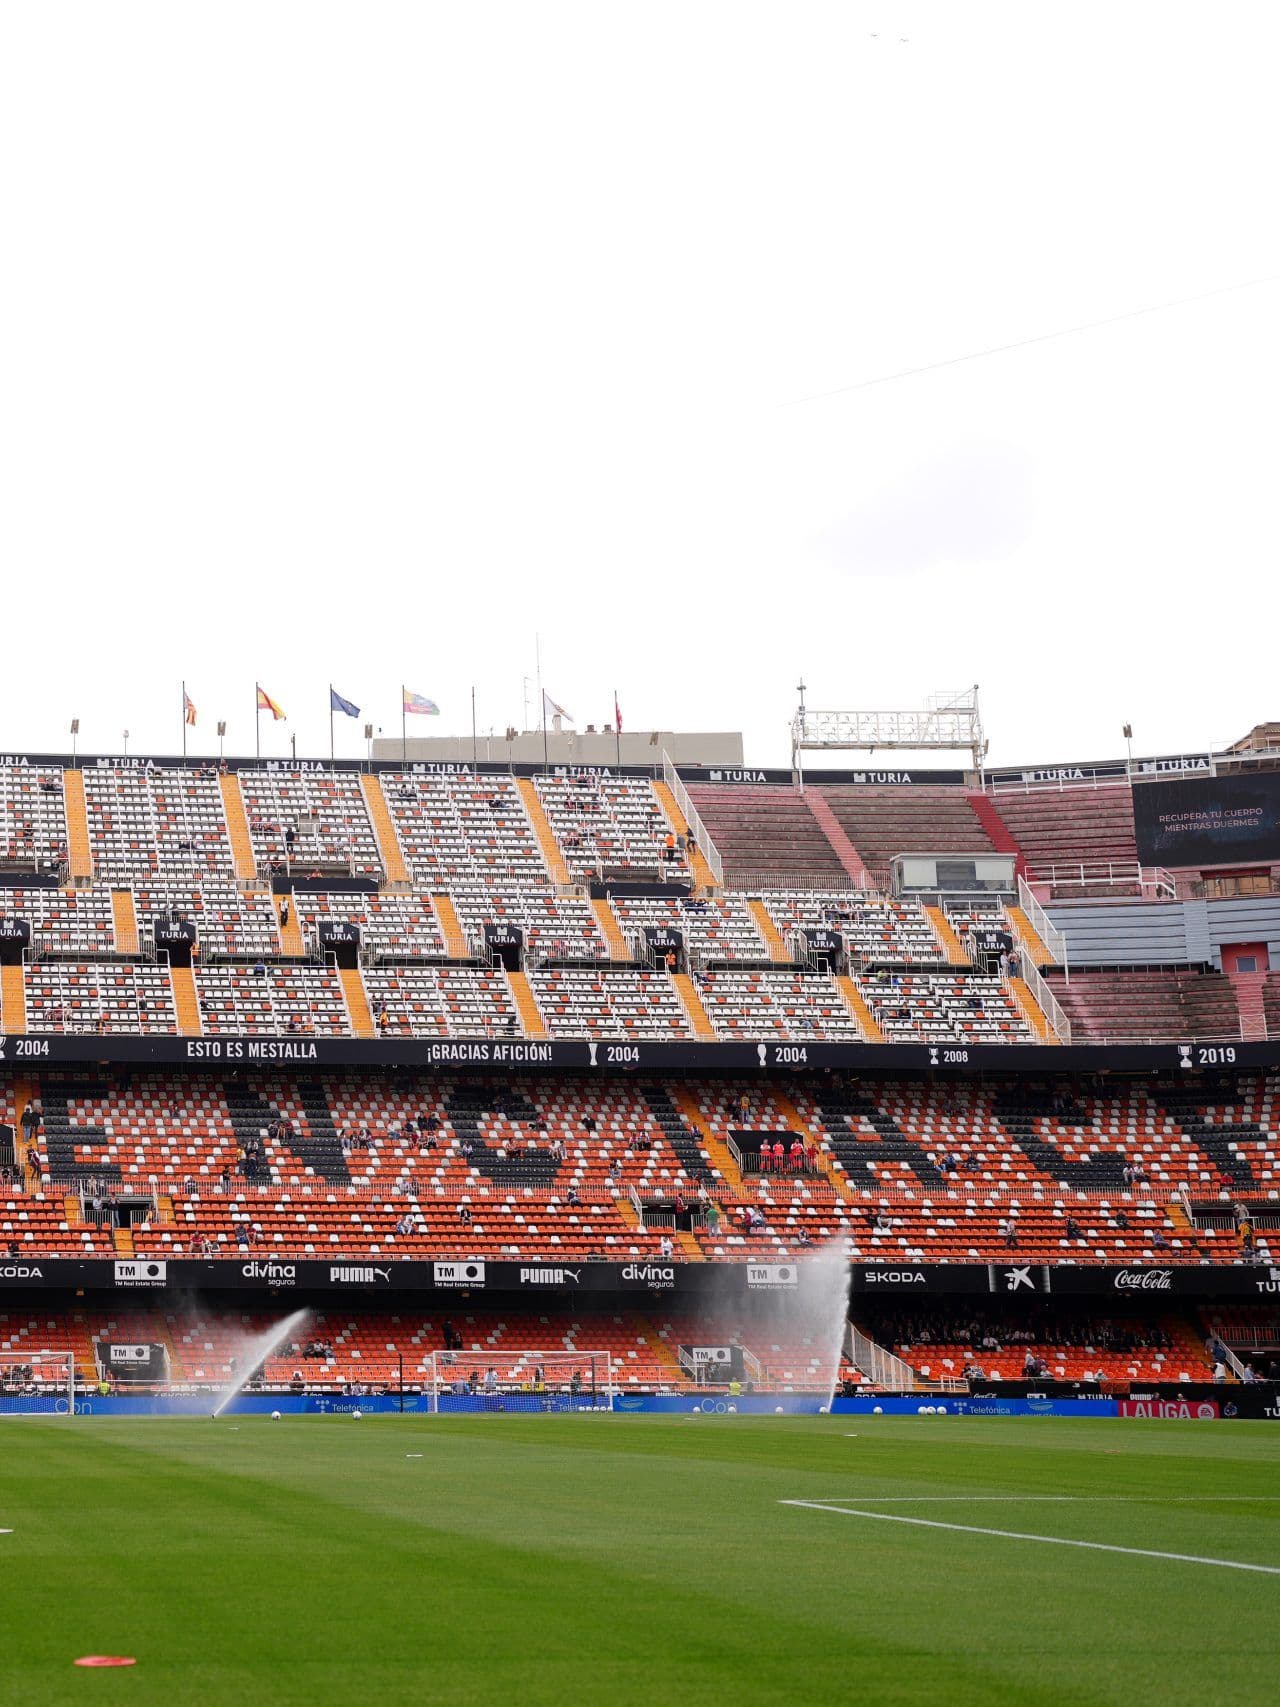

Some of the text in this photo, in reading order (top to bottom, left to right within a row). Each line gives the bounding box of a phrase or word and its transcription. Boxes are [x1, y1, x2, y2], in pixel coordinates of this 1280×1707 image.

[111, 758, 155, 769] TURIA
[282, 761, 324, 772] TURIA
[428, 763, 471, 774] TURIA
[1160, 758, 1208, 771] TURIA
[570, 766, 612, 778] TURIA
[724, 770, 767, 782] TURIA
[868, 772, 911, 783] TURIA
[1038, 768, 1084, 781] TURIA
[1159, 807, 1263, 823] RECUPERA TU CUERPO
[1165, 818, 1259, 832] MIENTRAS DUERMES
[160, 930, 189, 940] TURIA
[325, 932, 353, 941] TURIA
[488, 935, 516, 944] TURIA
[648, 938, 676, 947] TURIA
[808, 940, 836, 949] TURIA
[977, 941, 1006, 950] TURIA
[16, 1040, 50, 1056] 2004
[187, 1042, 317, 1059] ESTO ES MESTALLA
[427, 1043, 552, 1063] ¡GRACIAS AFICIÓN!
[607, 1046, 640, 1062] 2004
[775, 1047, 808, 1063] 2004
[943, 1050, 969, 1063] 2008
[1199, 1047, 1236, 1064] 2019
[118, 1266, 135, 1276] TM
[242, 1261, 296, 1278] divina
[330, 1267, 375, 1282] PUMA
[438, 1267, 455, 1277] TM
[622, 1264, 674, 1280] divina
[751, 1269, 768, 1279] TM
[520, 1268, 566, 1283] PUMA
[865, 1272, 926, 1283] SKODA
[1114, 1269, 1172, 1289] Coca-Cola
[268, 1278, 296, 1287] seguros
[647, 1281, 674, 1289] seguros
[1256, 1281, 1280, 1292] TU
[113, 1349, 127, 1357] TM
[695, 1351, 709, 1359] TM
[970, 1405, 1011, 1414] Telefónica
[1122, 1402, 1192, 1419] LALIGA
